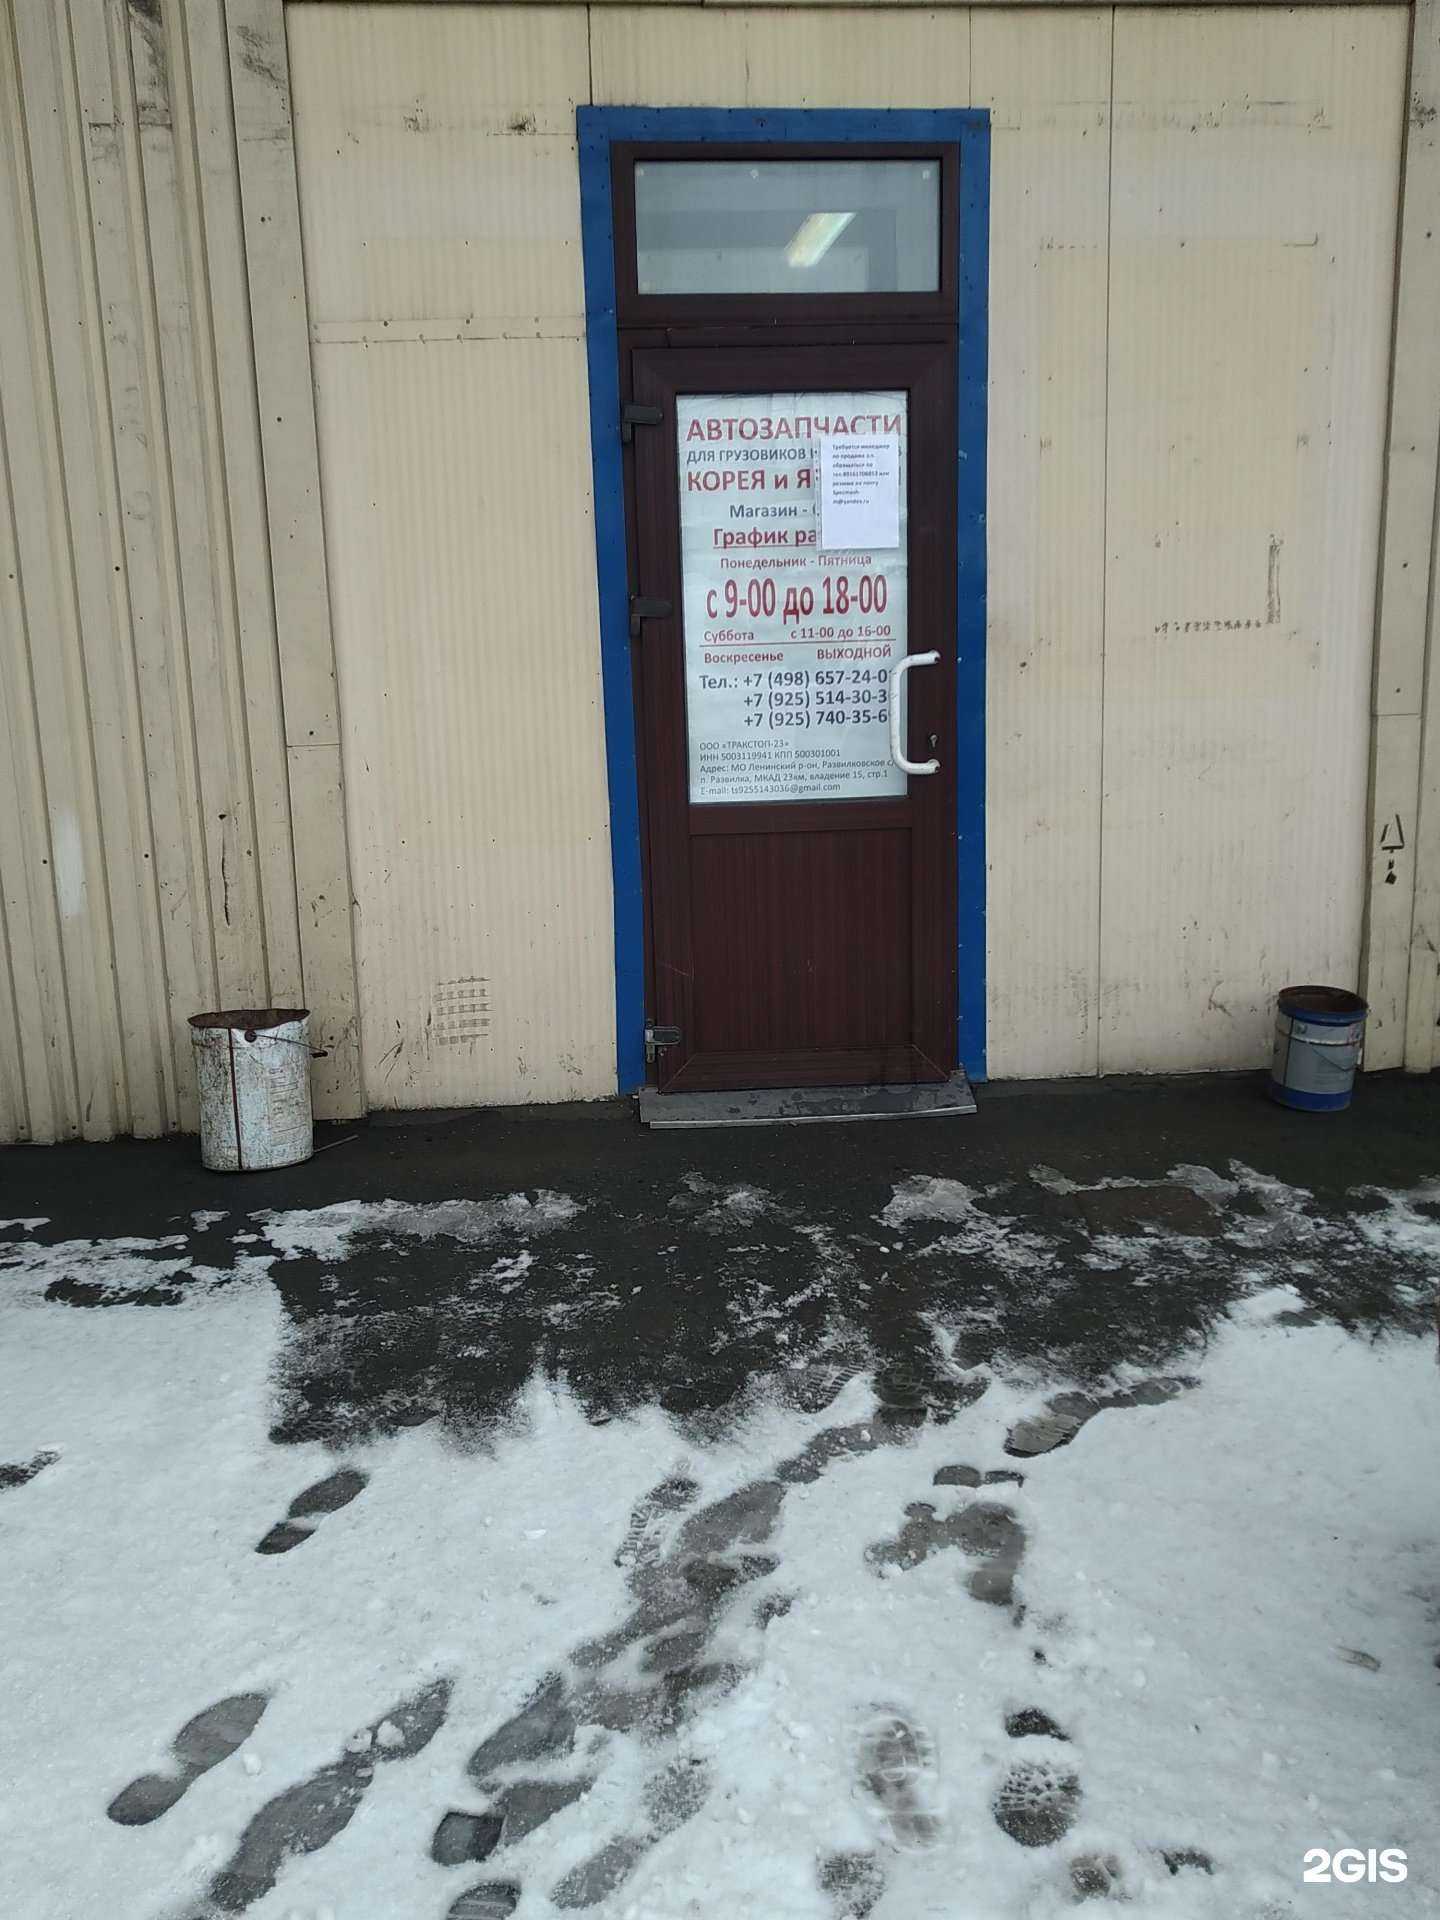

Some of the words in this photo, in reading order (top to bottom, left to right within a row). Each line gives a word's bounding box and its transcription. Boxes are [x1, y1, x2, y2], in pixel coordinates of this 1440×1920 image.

[686, 414, 902, 441] АВТОЗАПЧАСТИ
[686, 450, 716, 465] ДЛЯ
[720, 448, 806, 462] ГРУЗОВИКОВ
[687, 470, 766, 491] КОРЕЯ
[774, 474, 788, 490] и
[730, 504, 798, 518] Магазин
[713, 526, 788, 549] График
[720, 556, 806, 570] Понедельник
[818, 553, 872, 568] Пятница
[706, 588, 718, 619] с
[724, 578, 776, 618] 9-00
[782, 586, 814, 625] до
[822, 574, 888, 616] 18-00
[704, 630, 754, 644] Суббота
[790, 630, 797, 640] с
[801, 626, 834, 639] 11-00
[837, 628, 854, 640] до
[857, 625, 891, 637] 16-00
[704, 652, 784, 665] Воскресенье
[816, 644, 892, 661] ВЫХОДНОЙ
[699, 674, 739, 690] Тел.:
[743, 674, 762, 688] +7
[768, 671, 810, 690] (498)
[816, 668, 890, 686] 657-24-0
[744, 693, 763, 708] +7
[768, 691, 810, 709] (925)
[816, 689, 888, 705] 514-30-3
[744, 713, 763, 728] +7
[768, 710, 811, 729] (925)
[816, 708, 888, 726] 740-35-6
[700, 742, 720, 750] ООО
[722, 739, 789, 750] «ТРАКСТОП-23»
[700, 753, 718, 762] ИНН
[774, 750, 792, 759] КПП
[794, 748, 840, 758] 500301001
[700, 765, 728, 774] Адрес:
[730, 764, 746, 772] МО
[748, 760, 796, 772] Ленинский
[798, 762, 820, 770] р-он,
[822, 760, 886, 769] Развилковское
[754, 774, 782, 783] МКАД
[810, 772, 850, 781] владение
[853, 771, 864, 780] 15,
[700, 786, 728, 796] E-mail:
